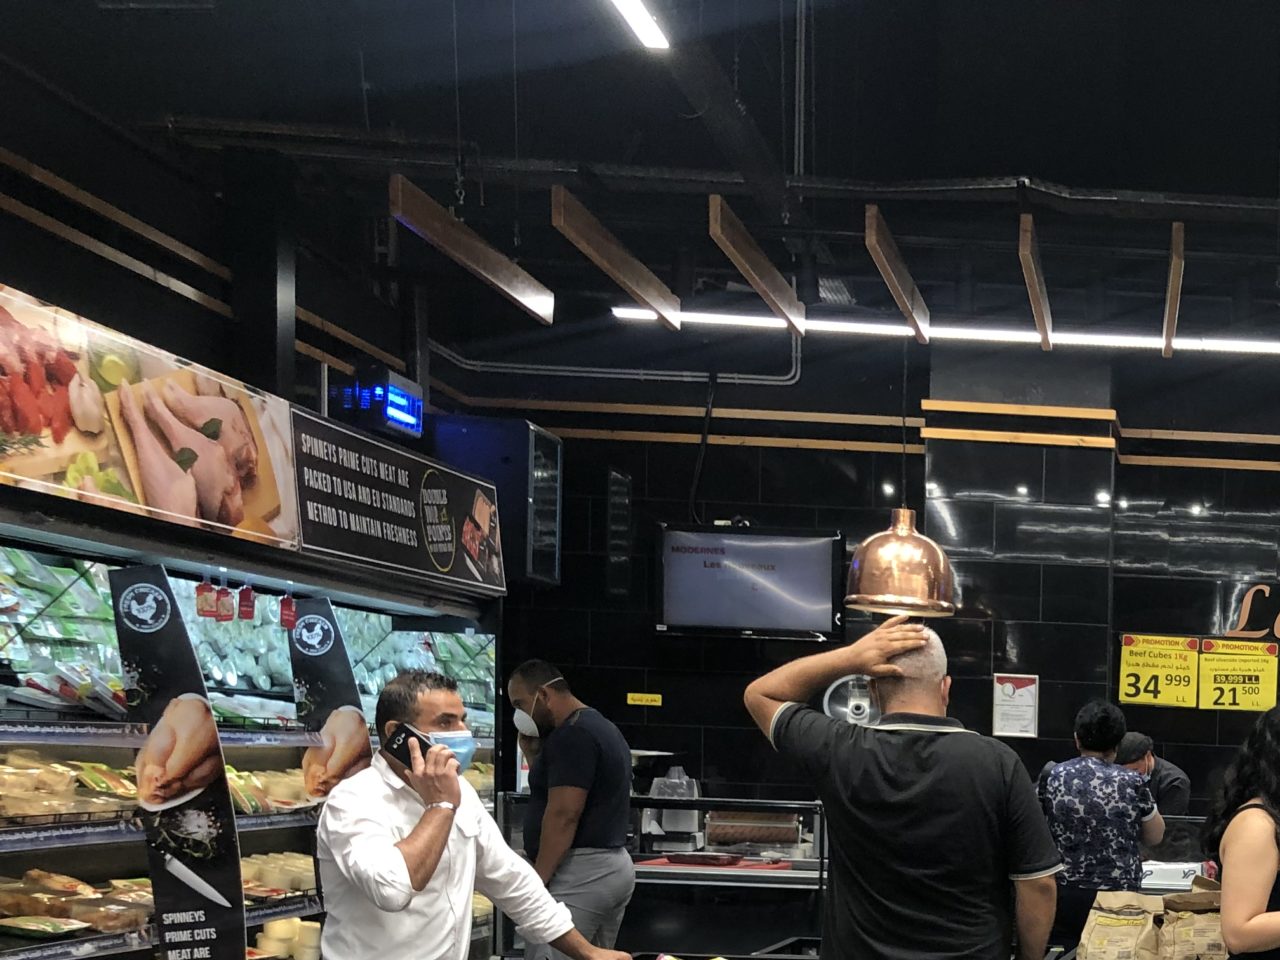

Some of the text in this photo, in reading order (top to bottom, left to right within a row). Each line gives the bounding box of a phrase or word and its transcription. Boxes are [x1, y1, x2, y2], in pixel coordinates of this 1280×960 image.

[301, 433, 410, 488] SPINNEYS PRIME CUTS MEAT ARE
[303, 467, 332, 492] PACKED
[332, 476, 342, 496] TO
[343, 479, 357, 501] USA
[358, 484, 372, 506] AND
[372, 489, 381, 508] EU
[381, 491, 416, 518] STANDARDS
[306, 500, 418, 548] METHOD TO MAINTAIN FRESHNESS
[671, 546, 726, 555] MODERNES
[703, 561, 722, 569] Les
[1142, 638, 1180, 647] PROMOTION
[1221, 643, 1259, 652] PROMOTION
[1129, 650, 1146, 658] Beef
[1148, 651, 1172, 660] Cubes
[1124, 673, 1191, 699] 34 999
[1215, 675, 1243, 684] 39,999
[1213, 687, 1260, 706] 21 500
[162, 910, 205, 925] SPINNEYS
[165, 928, 217, 943] PRIME CUTS
[167, 947, 211, 960] MEAT ARE
